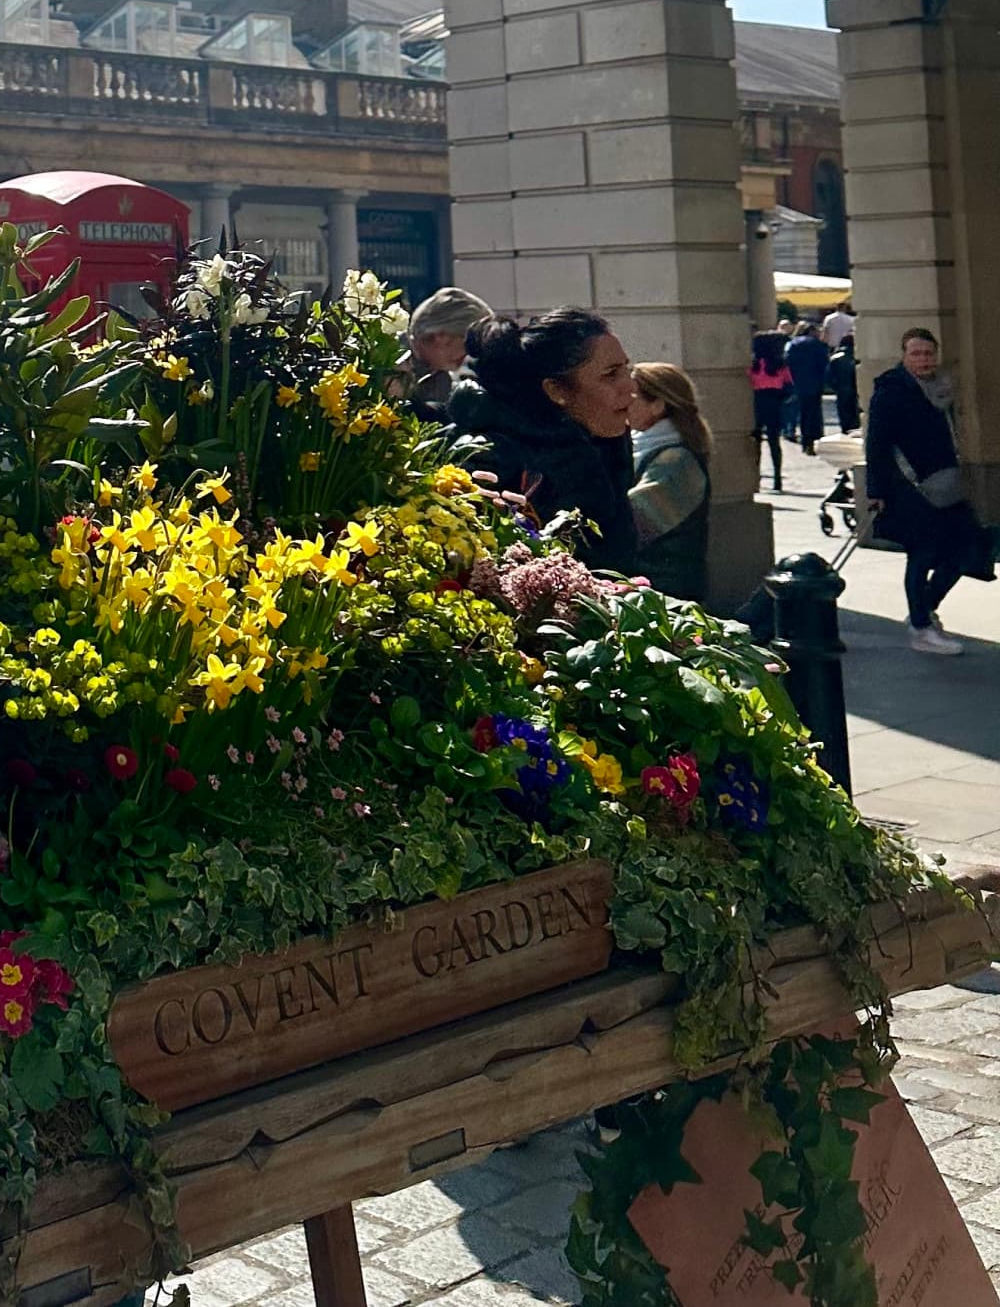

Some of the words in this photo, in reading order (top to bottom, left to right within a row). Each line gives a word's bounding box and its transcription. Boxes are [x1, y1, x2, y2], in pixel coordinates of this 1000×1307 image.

[81, 222, 169, 241] TELEPHONE
[153, 943, 375, 1056] COVENT
[411, 880, 594, 979] GARDEN
